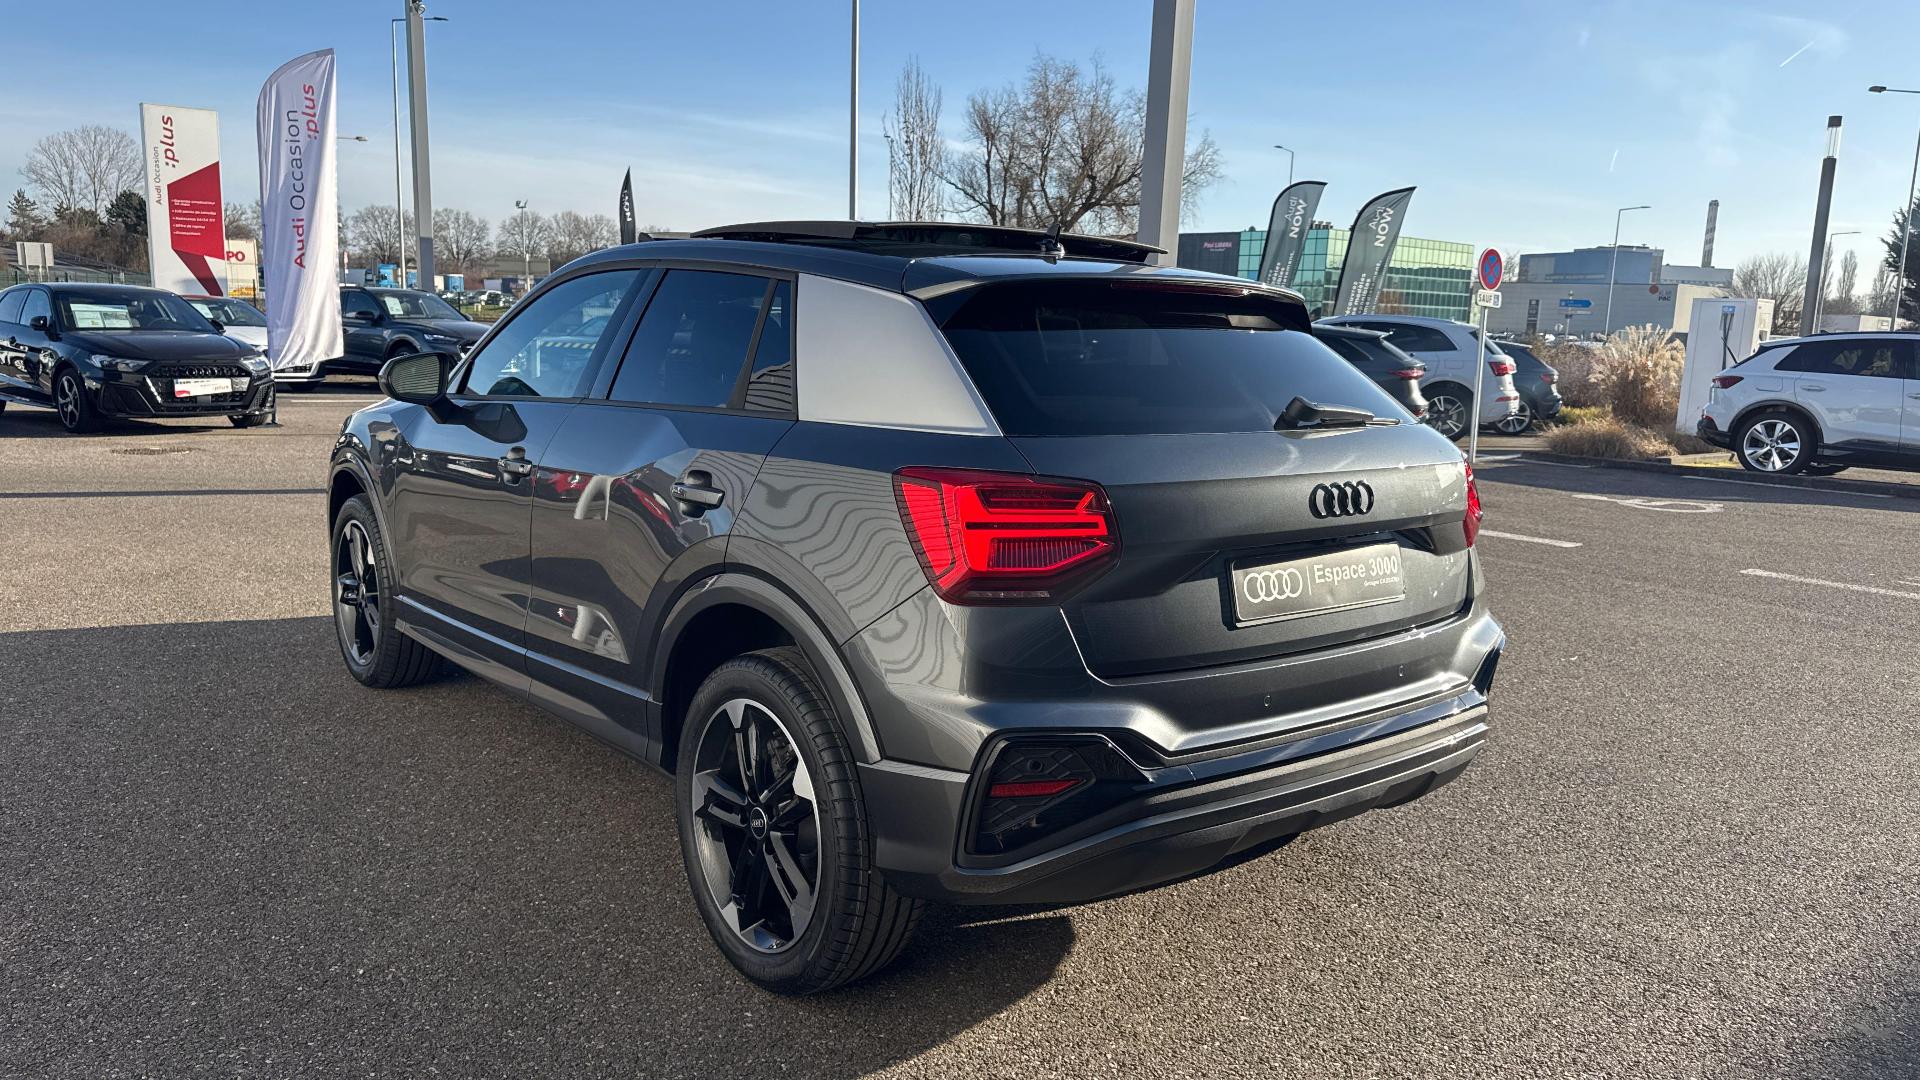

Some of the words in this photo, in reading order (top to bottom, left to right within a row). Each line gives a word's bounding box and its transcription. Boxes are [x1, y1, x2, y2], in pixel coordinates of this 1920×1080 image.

[301, 84, 319, 140] :plus
[160, 115, 179, 168] :plus
[285, 110, 305, 210] Occasion
[153, 147, 161, 183] Occasion
[154, 186, 162, 205] Audi
[1284, 196, 1298, 221] Audi
[1288, 199, 1307, 238] NOW
[1373, 207, 1394, 247] NOW
[291, 218, 306, 269] Audi
[1478, 293, 1493, 304] SAUF
[1313, 563, 1366, 585] Espace
[1368, 555, 1398, 577] 3000
